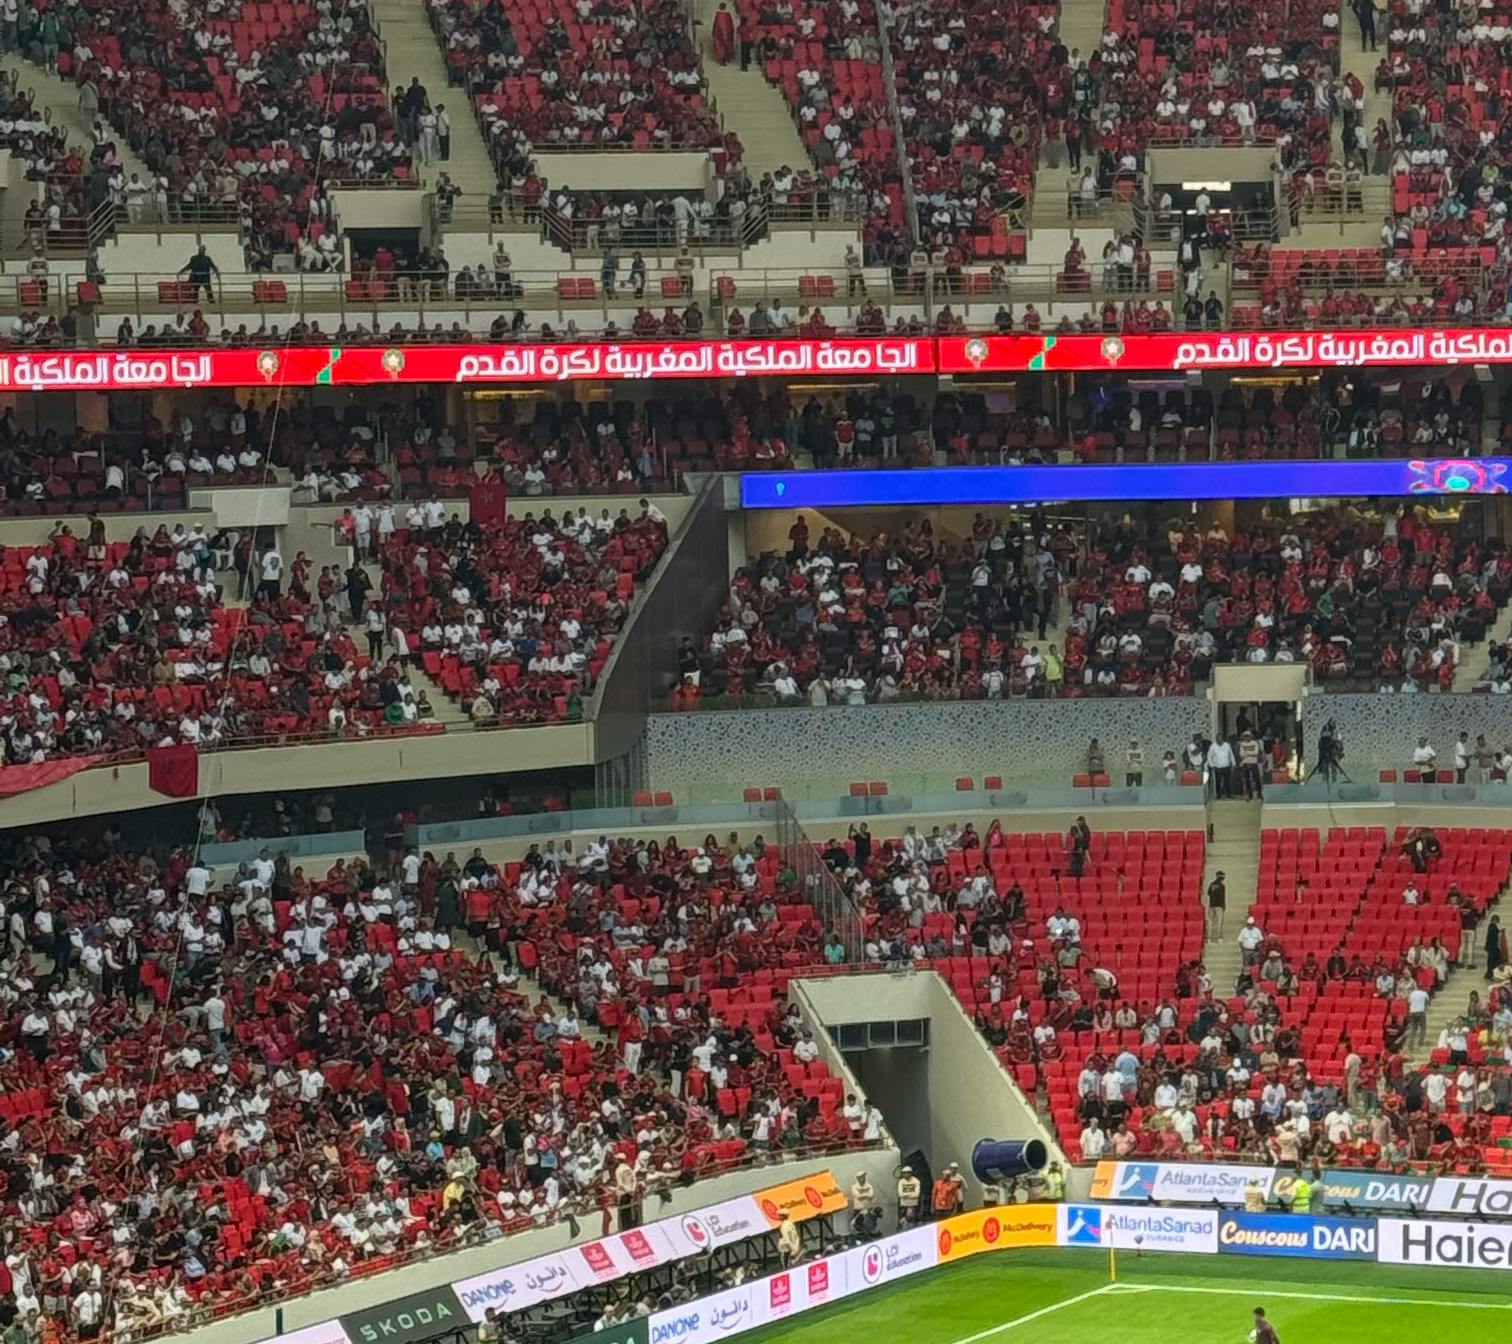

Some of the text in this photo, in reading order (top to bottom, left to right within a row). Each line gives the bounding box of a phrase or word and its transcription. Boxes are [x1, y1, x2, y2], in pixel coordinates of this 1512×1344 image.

[455, 349, 536, 383] القدم
[540, 348, 601, 381] لكرة
[605, 345, 713, 379] المغربية
[717, 343, 813, 377] الملكية
[1173, 337, 1250, 370] القدم
[1254, 336, 1314, 368] لكرة
[1318, 333, 1425, 367] المغربية
[13, 356, 109, 390] الملكية
[1160, 1170, 1269, 1188] AtlantaSand
[1364, 1181, 1430, 1204] DARI
[1108, 1213, 1214, 1235] AtlantaSanad
[1220, 1220, 1375, 1254] Couscous DARI
[360, 1302, 453, 1342] SKODA
[651, 1312, 700, 1344] DANONE
